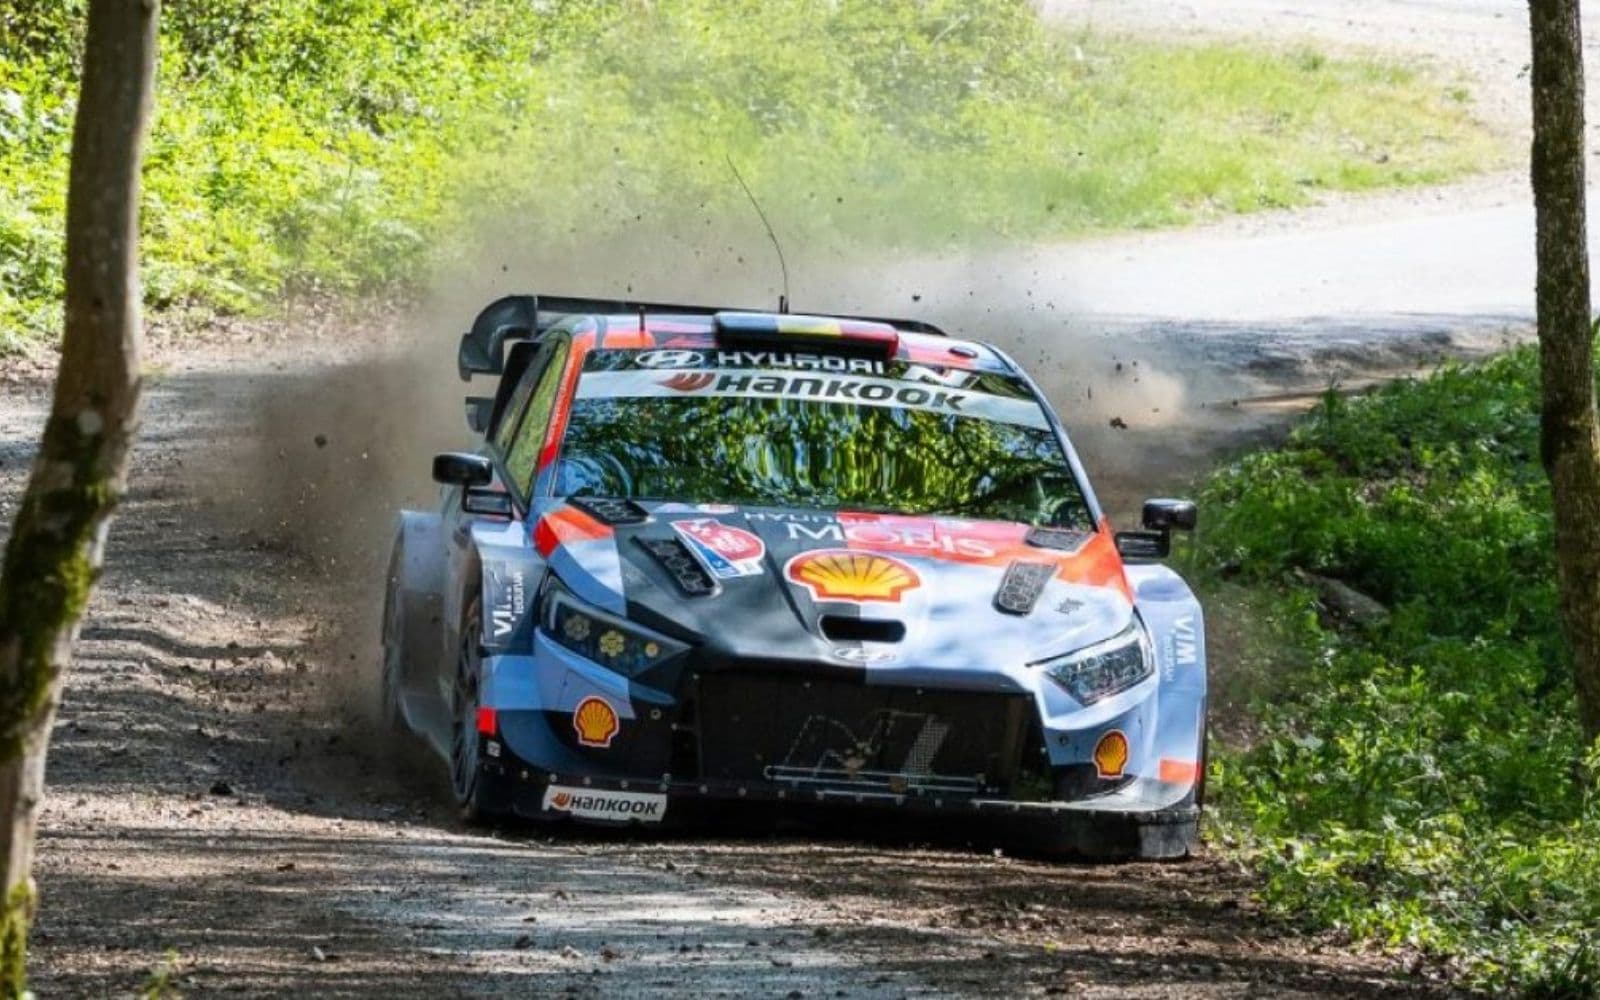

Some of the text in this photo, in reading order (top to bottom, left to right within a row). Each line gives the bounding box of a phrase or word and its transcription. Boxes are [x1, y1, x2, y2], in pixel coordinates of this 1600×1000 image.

[718, 351, 885, 375] HYUNDAI
[787, 521, 996, 558] MOBIS
[1175, 615, 1196, 665] VIM
